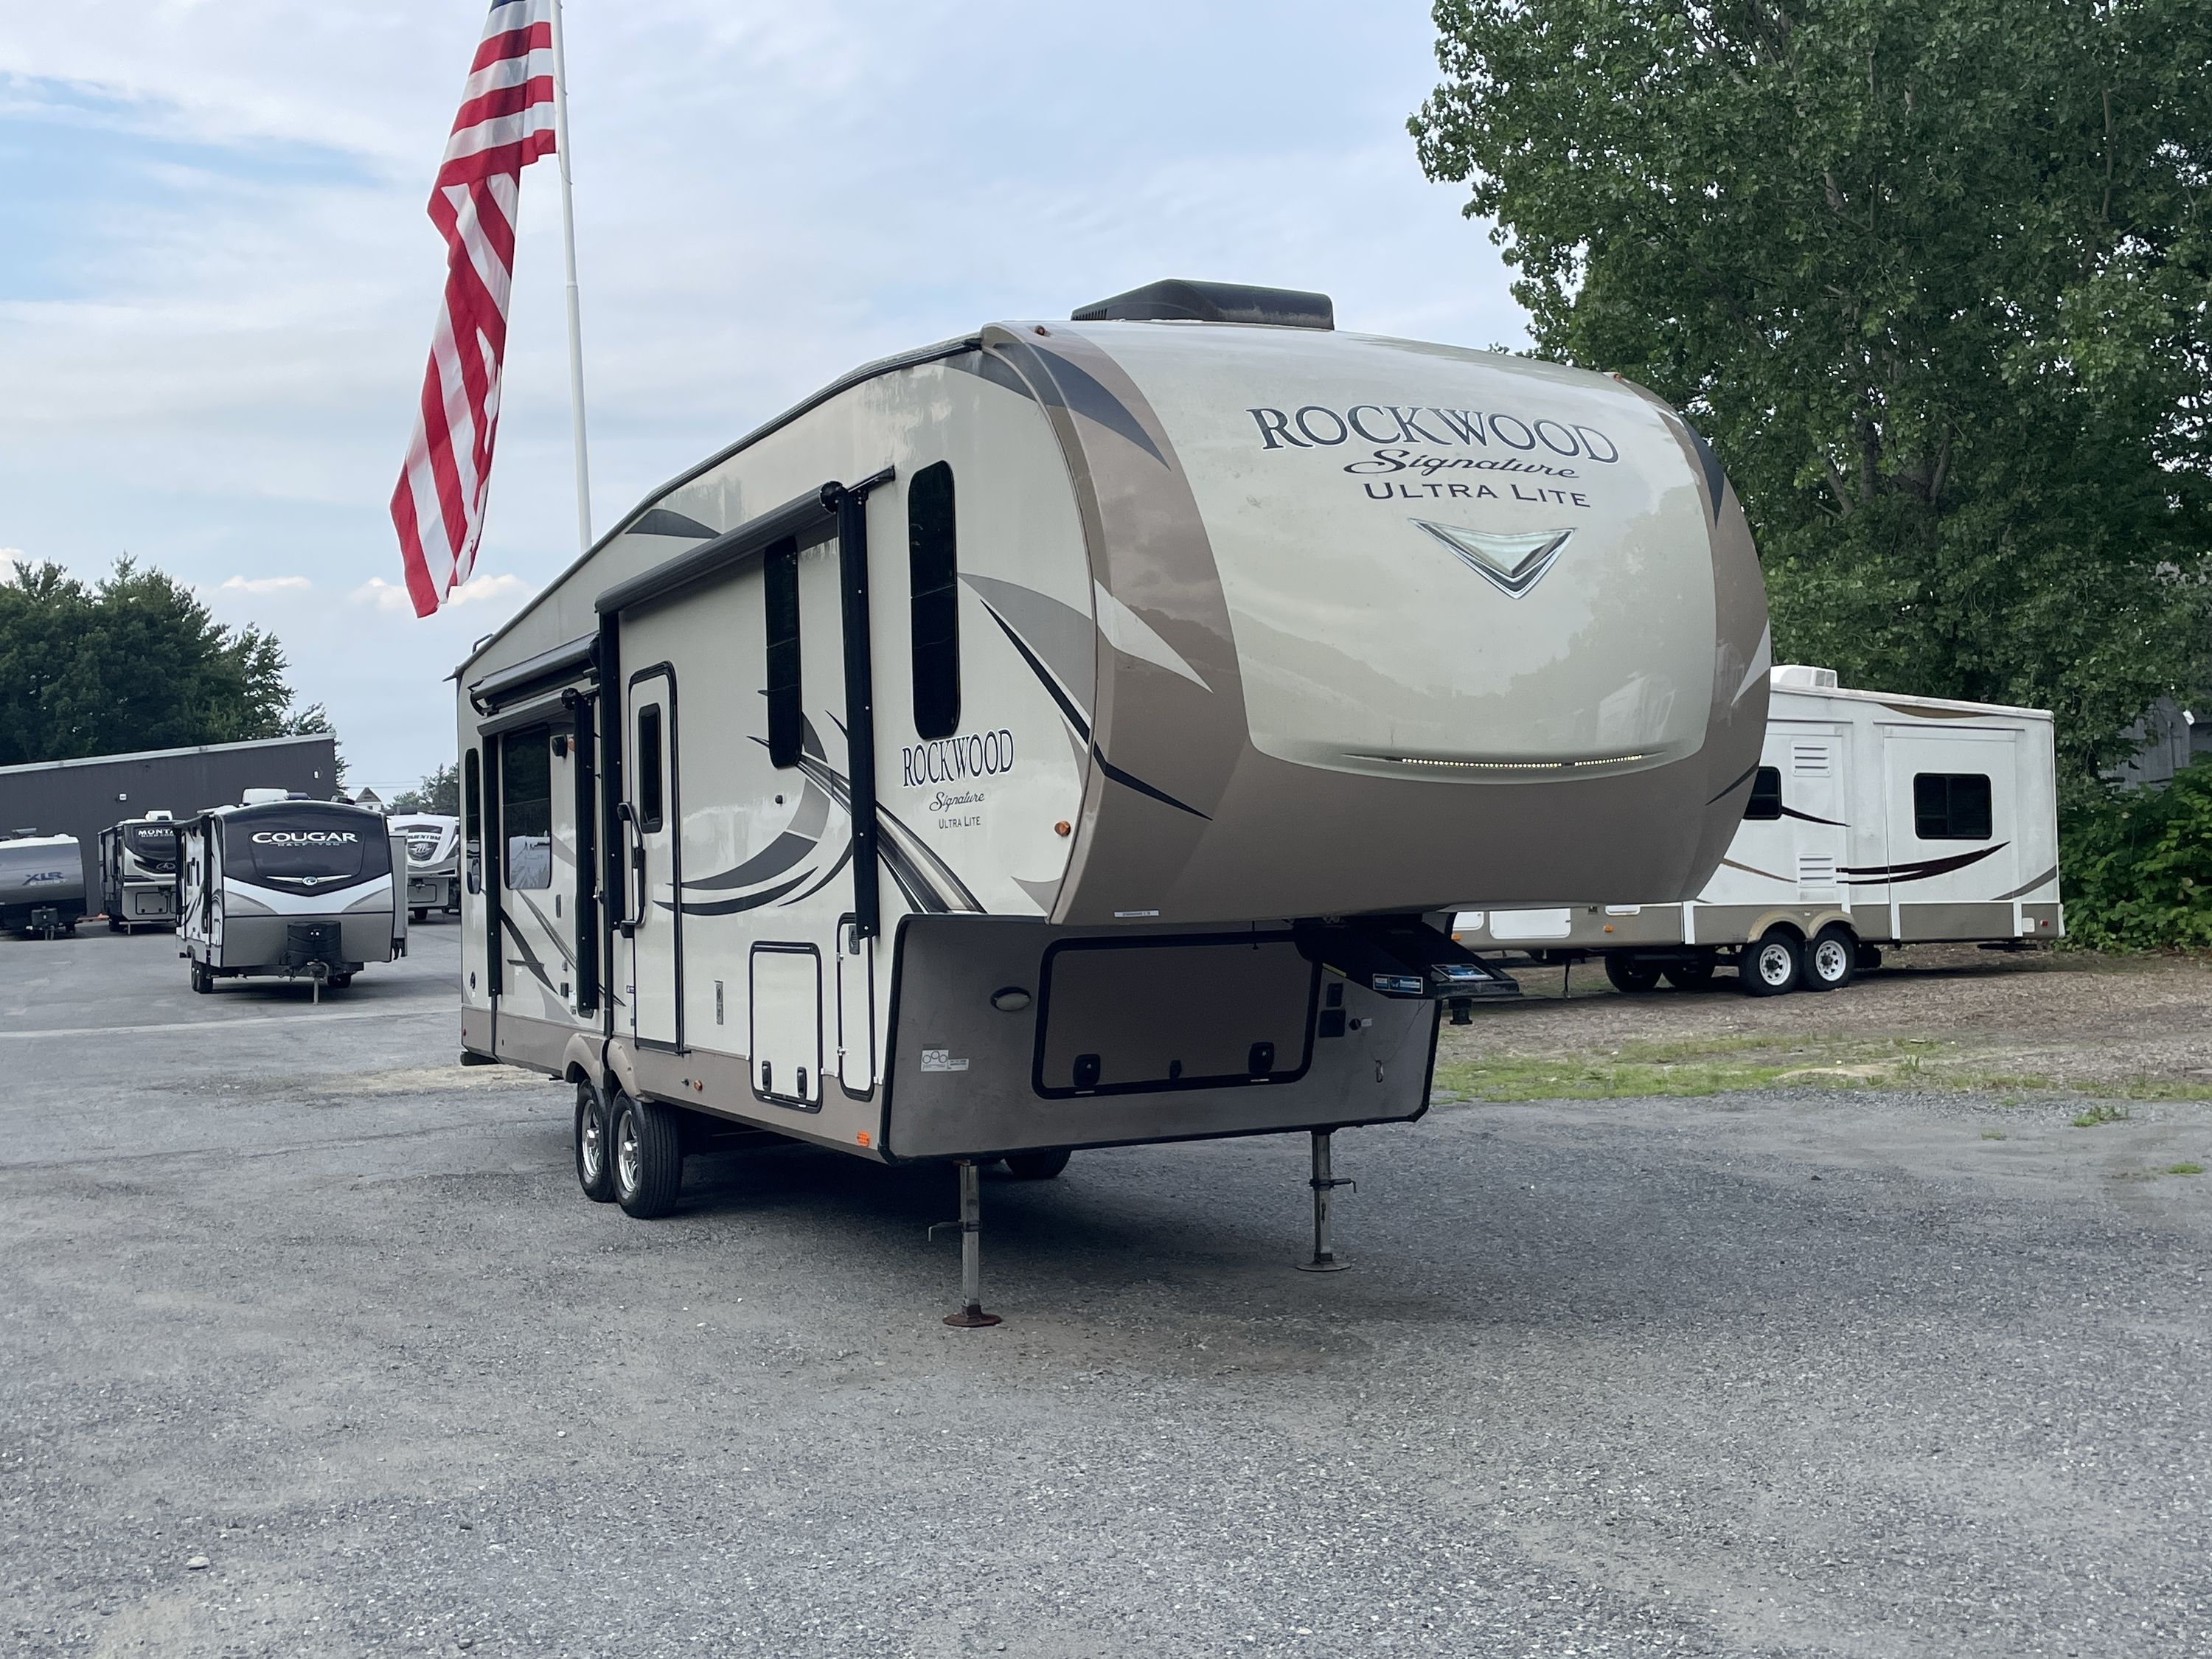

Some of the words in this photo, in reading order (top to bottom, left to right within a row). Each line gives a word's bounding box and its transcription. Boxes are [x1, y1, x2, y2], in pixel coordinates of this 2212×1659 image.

[1245, 406, 1619, 464] ROCKWOOD
[1343, 449, 1579, 479] Signature
[1364, 482, 1498, 500] ULTRA
[1514, 484, 1591, 508] LITE
[902, 728, 1015, 787] ROCKWOOD
[929, 791, 985, 813] Signature
[939, 818, 961, 830] ULTRA
[964, 816, 981, 827] LITE
[251, 832, 358, 844] COUGAR
[22, 872, 64, 886] XLR
